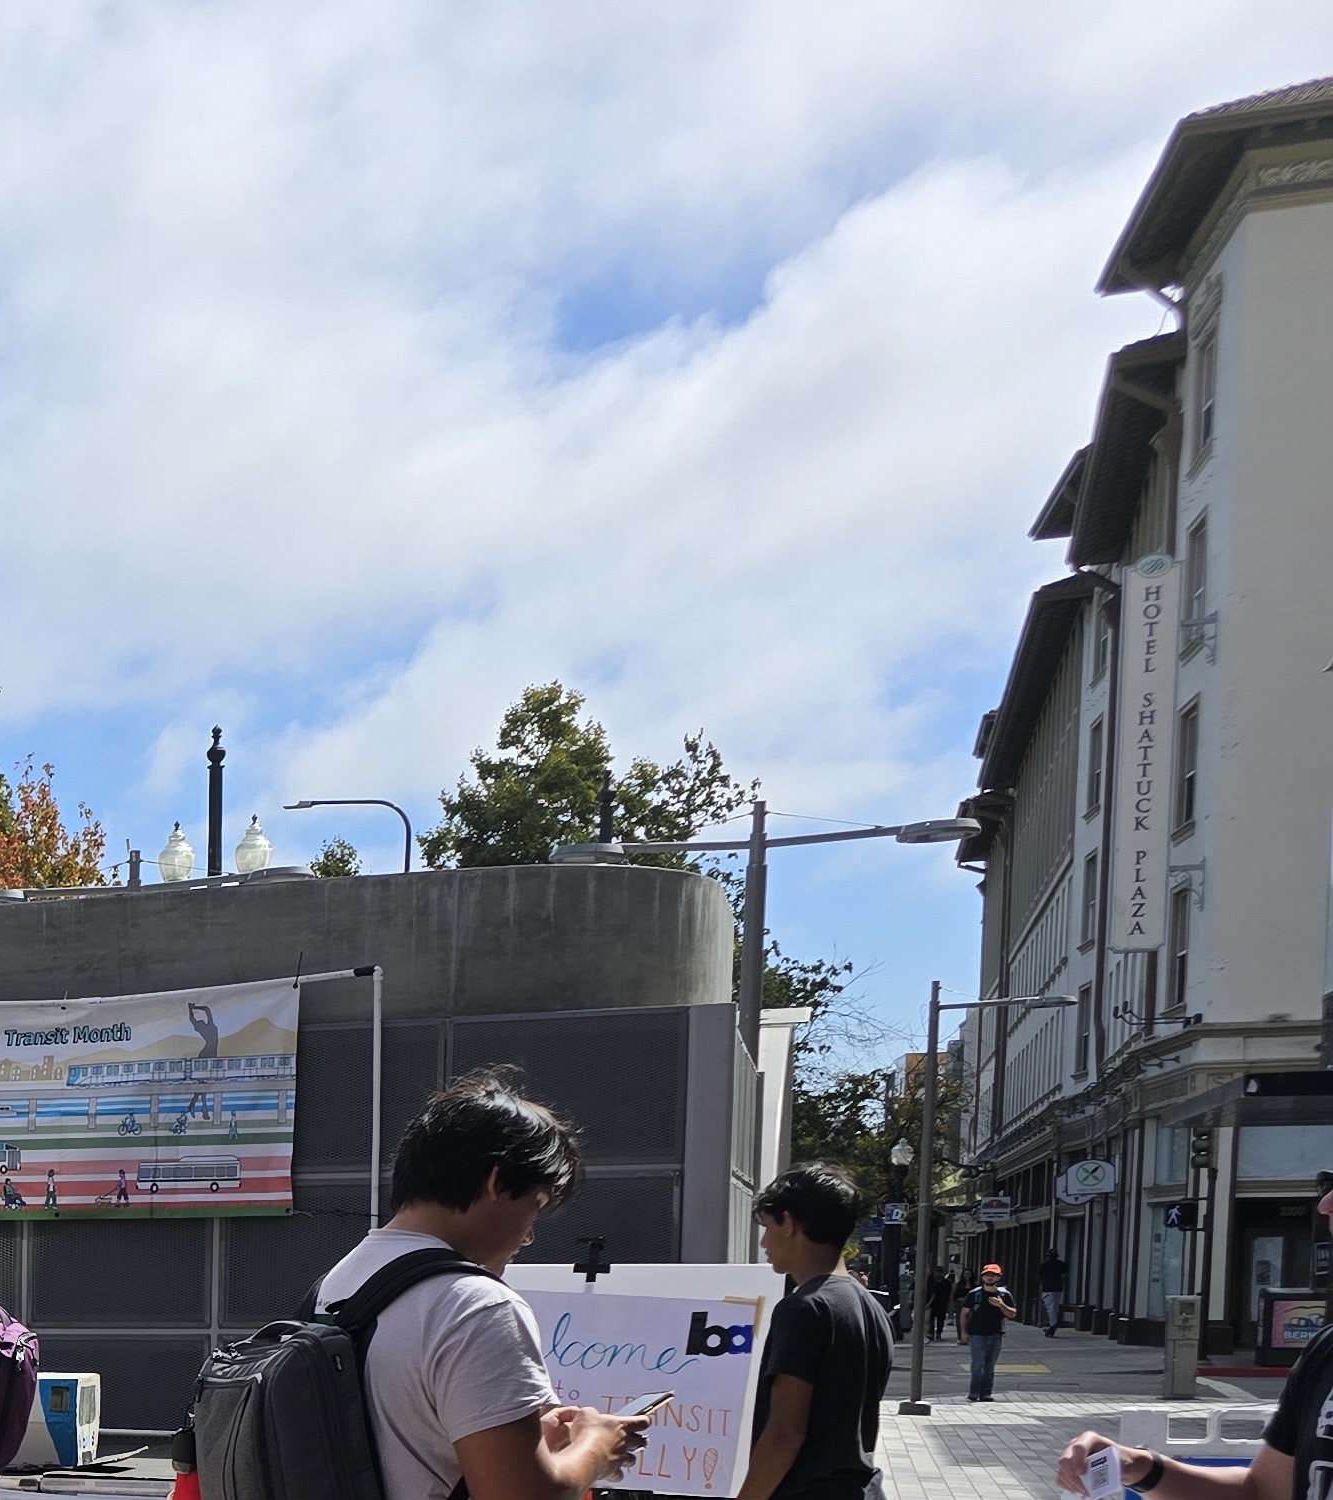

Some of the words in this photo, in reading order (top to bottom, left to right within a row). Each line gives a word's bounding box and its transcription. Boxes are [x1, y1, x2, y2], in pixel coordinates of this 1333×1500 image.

[1143, 585, 1162, 674] HOTEL
[1132, 692, 1157, 832] SHATTUCK
[1128, 850, 1147, 936] PLAZA
[4, 1027, 70, 1046] Transit
[73, 1022, 132, 1044] Month
[544, 1312, 700, 1375] lcome
[554, 1380, 580, 1401] to
[627, 1443, 719, 1490] LLY!
